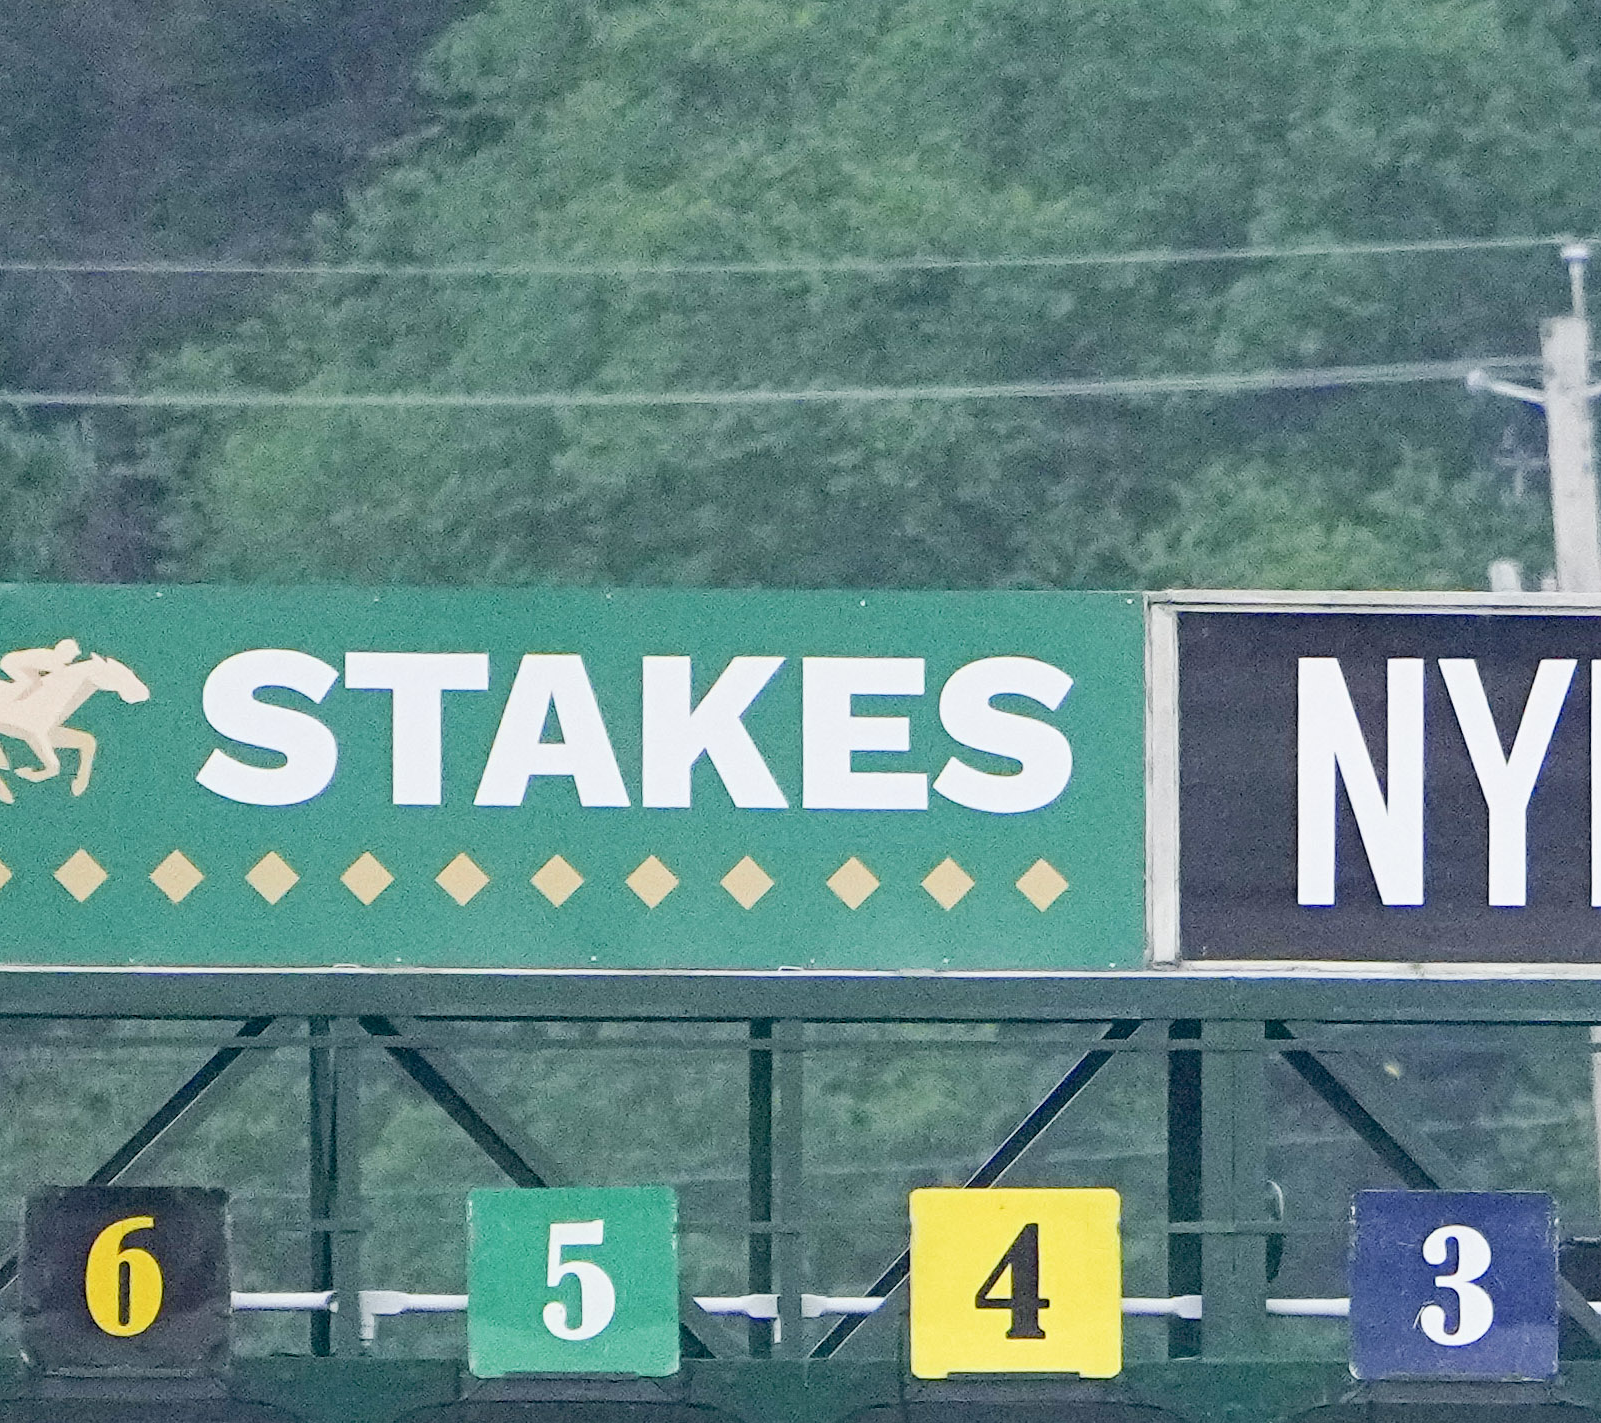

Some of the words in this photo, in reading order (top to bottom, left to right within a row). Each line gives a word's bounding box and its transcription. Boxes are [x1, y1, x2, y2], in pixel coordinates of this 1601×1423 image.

[195, 648, 1074, 814] STAKES
[85, 1216, 163, 1337] 6
[542, 1219, 616, 1341] 5
[975, 1222, 1050, 1340] 4
[1419, 1224, 1494, 1347] 3
